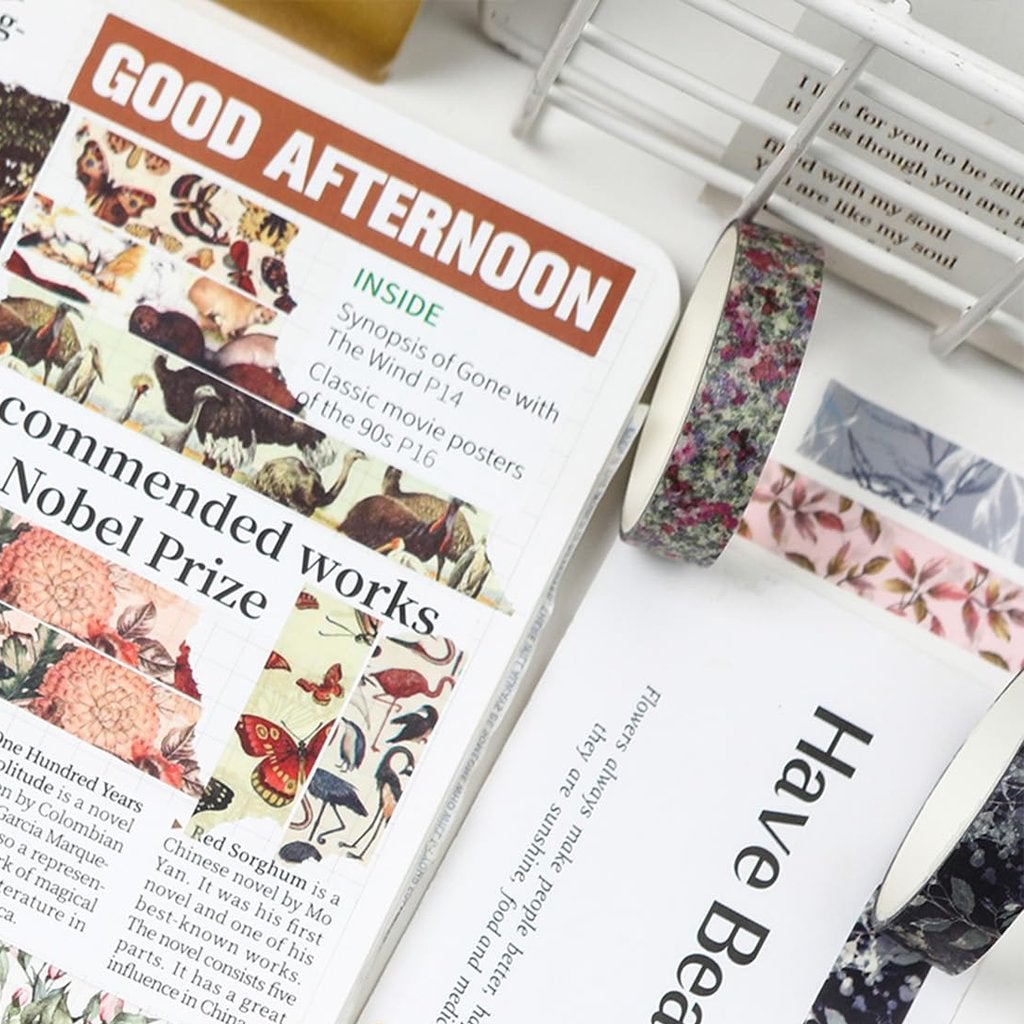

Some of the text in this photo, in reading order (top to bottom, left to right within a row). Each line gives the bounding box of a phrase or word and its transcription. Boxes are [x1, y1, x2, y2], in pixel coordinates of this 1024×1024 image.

[828, 121, 1010, 217] as though you are
[855, 106, 986, 178] for you to be
[91, 42, 613, 332] GOOD AFTERNOON
[353, 267, 444, 327] INSIDE
[327, 327, 464, 408] The Wind P14
[337, 302, 559, 424] Synopsis of Gone with
[292, 391, 437, 468] of the 90s P16
[308, 361, 524, 480] Classic movie posters
[144, 531, 267, 620] Prize
[301, 544, 439, 638] works
[14, 788, 36, 812] by
[37, 801, 124, 853] Colombian
[25, 746, 99, 792] Hundred
[101, 781, 143, 813] Years
[56, 785, 71, 803] is
[73, 798, 84, 810] a
[87, 804, 135, 833] novel
[516, 684, 661, 937] Flowers always make people
[733, 705, 874, 889] Have
[44, 828, 108, 868] Marque-
[163, 836, 332, 926] Chinese novel by Mo
[190, 824, 340, 906] Red Sorghum is a
[134, 894, 301, 985] best-known works.
[143, 879, 314, 966] novel and one of his
[155, 855, 322, 946] Yan. It was his first
[106, 954, 180, 1000] influence
[180, 988, 198, 1009] in
[113, 938, 164, 970] parts.
[172, 960, 187, 979] It
[190, 968, 222, 995] has
[225, 990, 236, 1003] a
[127, 914, 297, 1006] The novel consists five
[482, 942, 524, 996] better,
